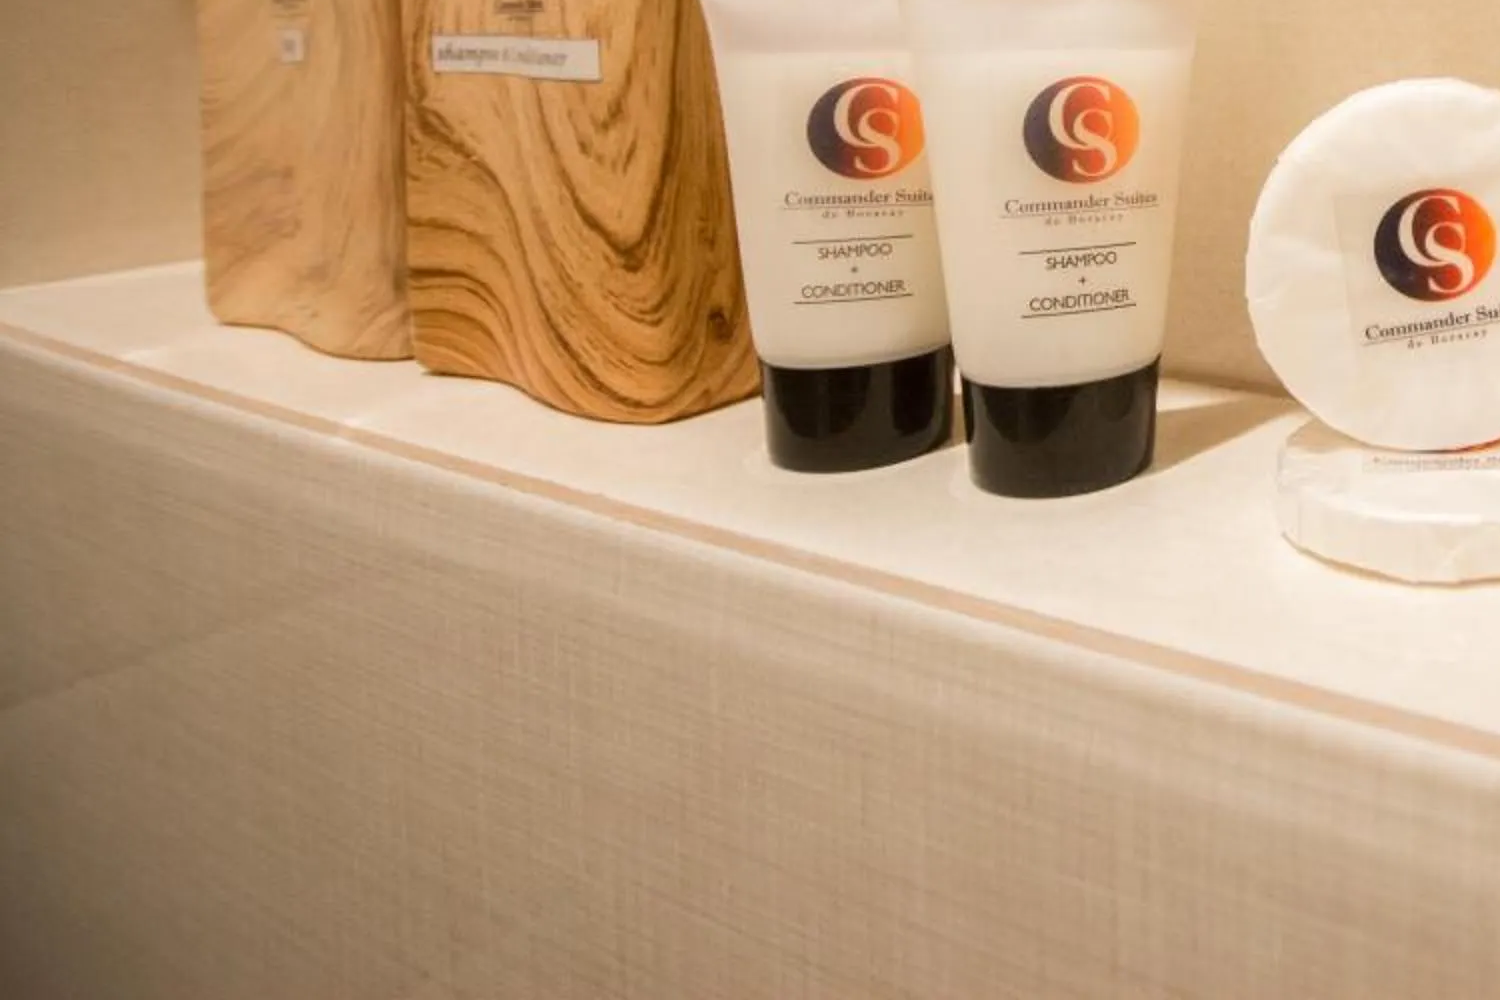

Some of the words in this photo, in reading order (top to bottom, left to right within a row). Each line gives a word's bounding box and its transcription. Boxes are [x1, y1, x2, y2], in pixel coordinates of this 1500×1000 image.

[784, 189, 890, 207] Commander
[895, 187, 934, 203] Suite
[1004, 193, 1109, 215] Commander
[1113, 191, 1158, 207] Suites
[818, 243, 893, 260] SHAMPOO
[1046, 251, 1118, 271] SHAMPOO
[801, 279, 907, 299] CONDITIONER
[1028, 289, 1130, 312] CONDITIONER
[1365, 312, 1472, 341] Commander
